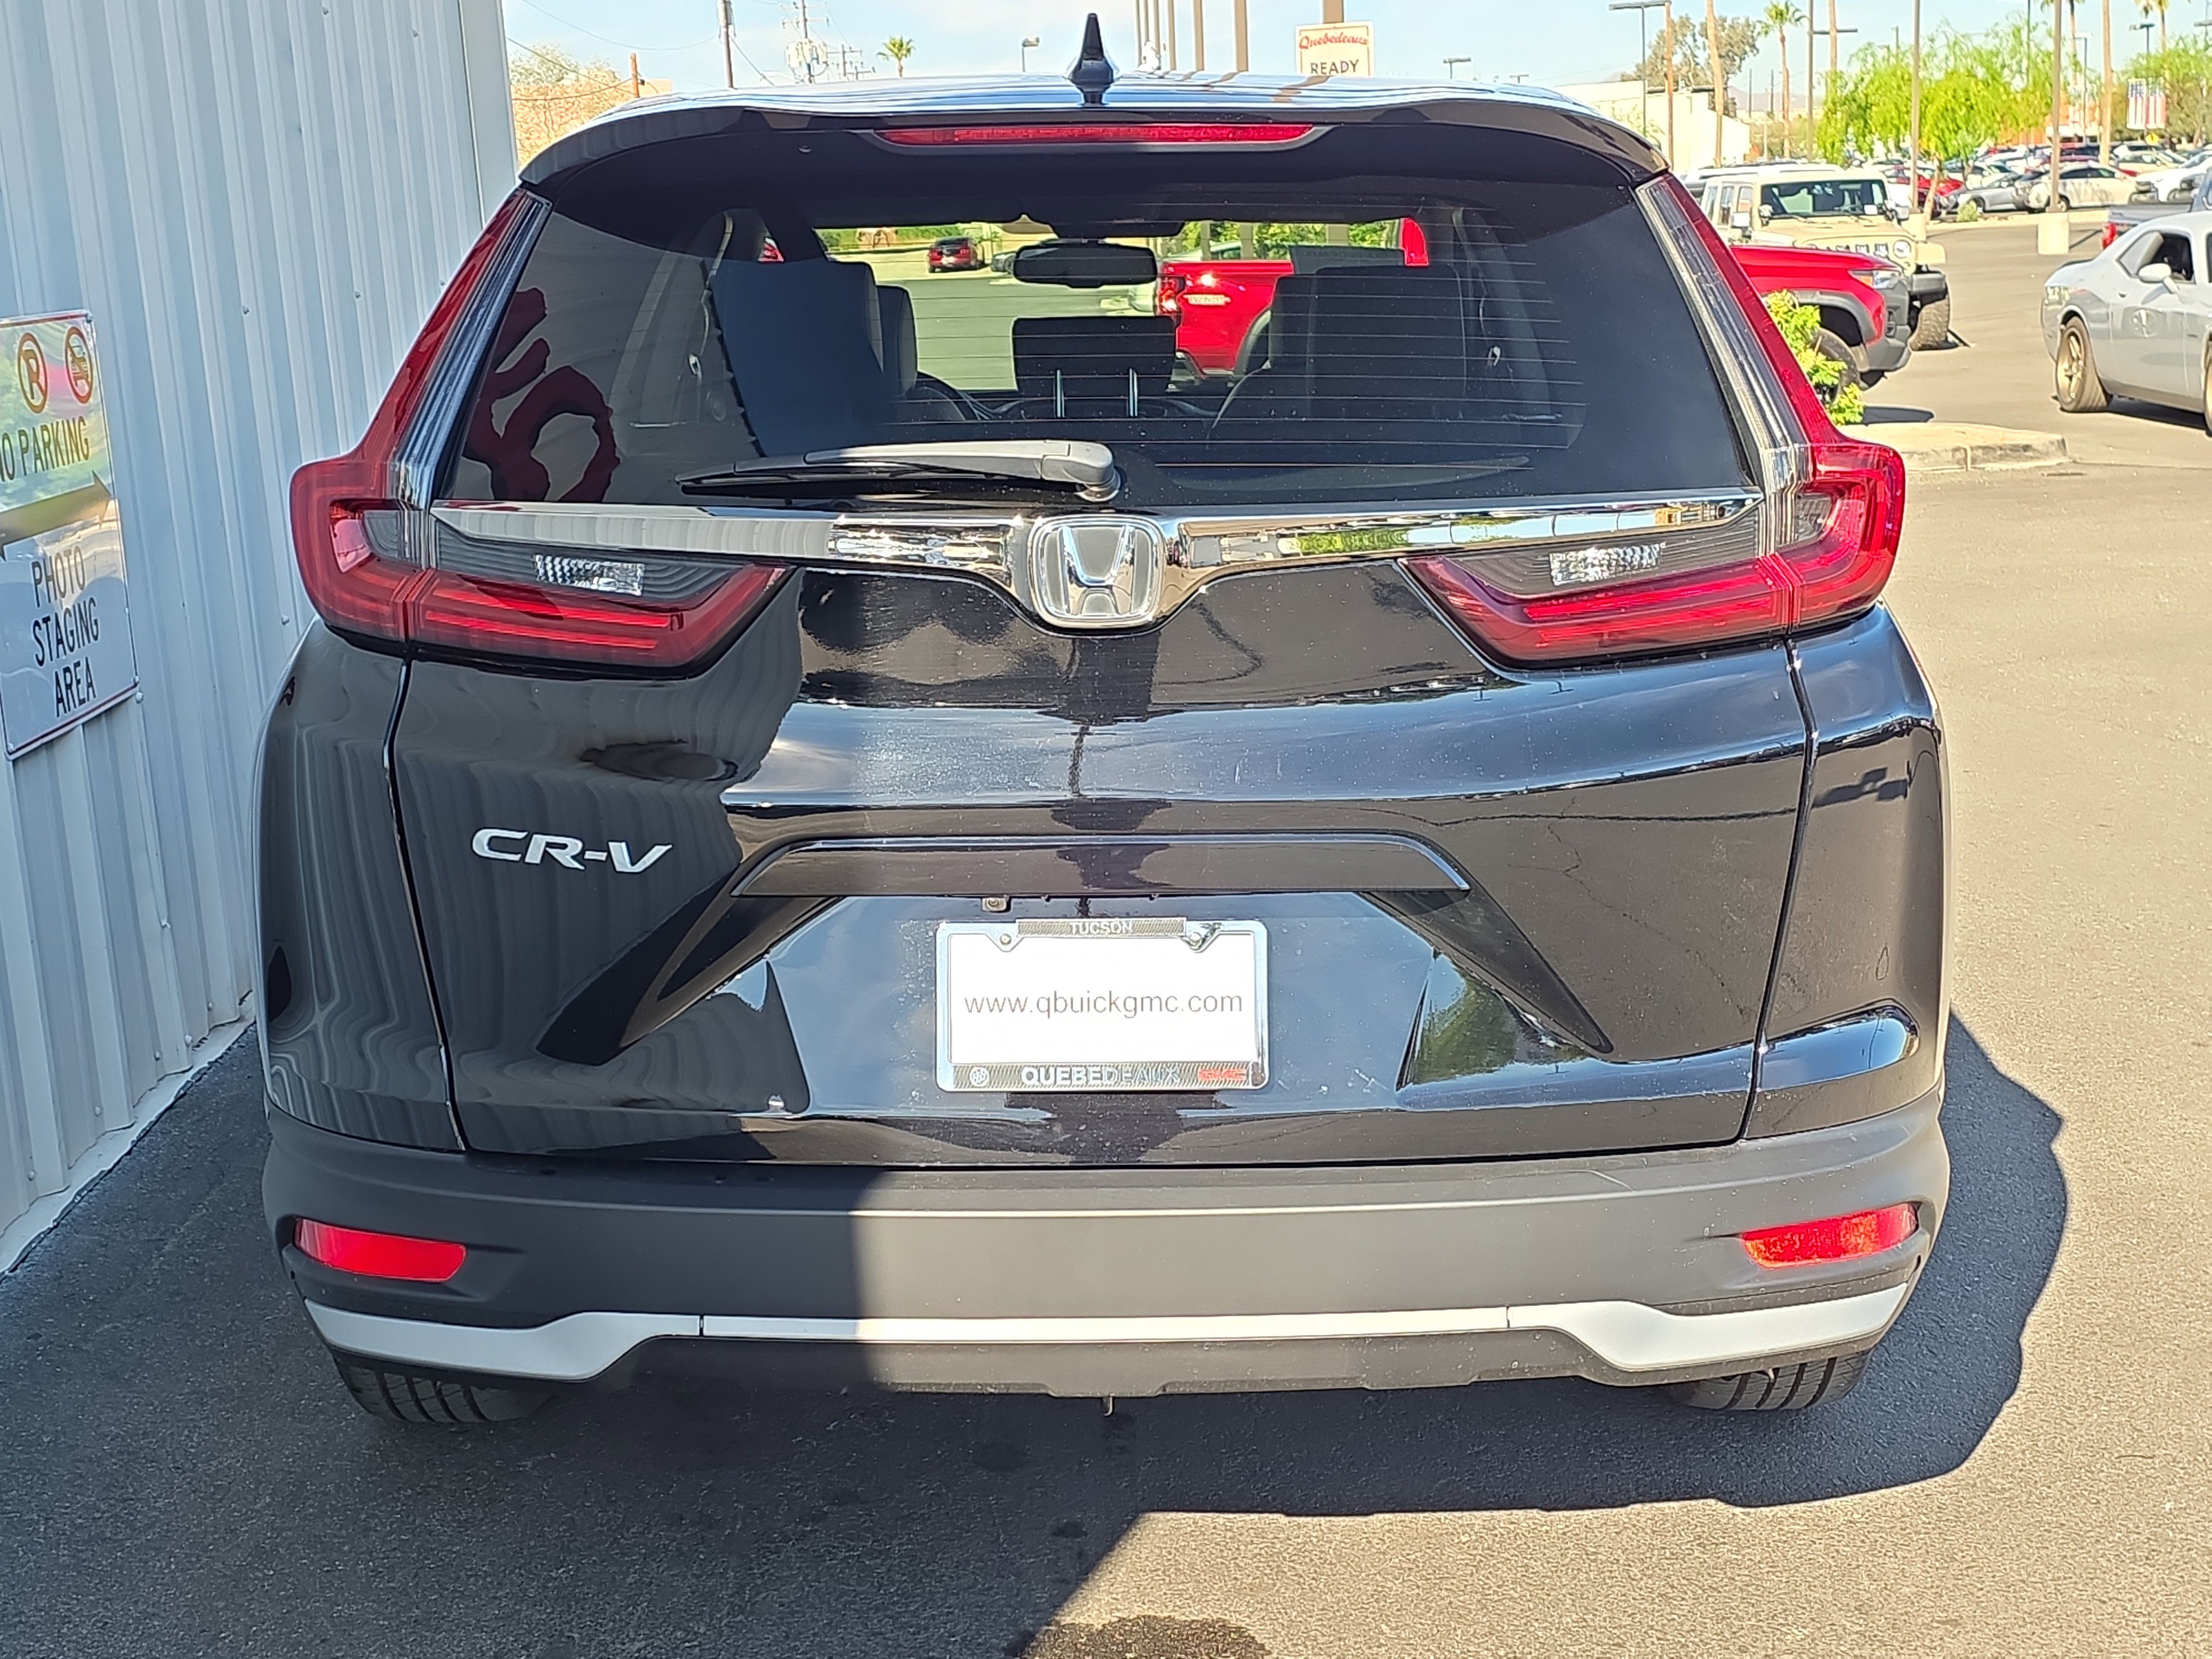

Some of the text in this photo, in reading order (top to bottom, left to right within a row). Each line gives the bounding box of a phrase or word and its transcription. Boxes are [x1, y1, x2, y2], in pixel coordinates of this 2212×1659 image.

[1299, 31, 1369, 49] Quebedeaux
[1310, 59, 1359, 74] READY
[17, 415, 89, 476] PARKING
[31, 545, 85, 608] PHOTO
[32, 597, 99, 667] STAGING
[54, 656, 97, 718] AREA
[472, 828, 673, 873] CR-V
[1069, 922, 1133, 934] TUCSON
[964, 991, 1243, 1019] www.qbuickgmc.com
[1021, 1066, 1247, 1086] QUEBEDEAUX GMC
